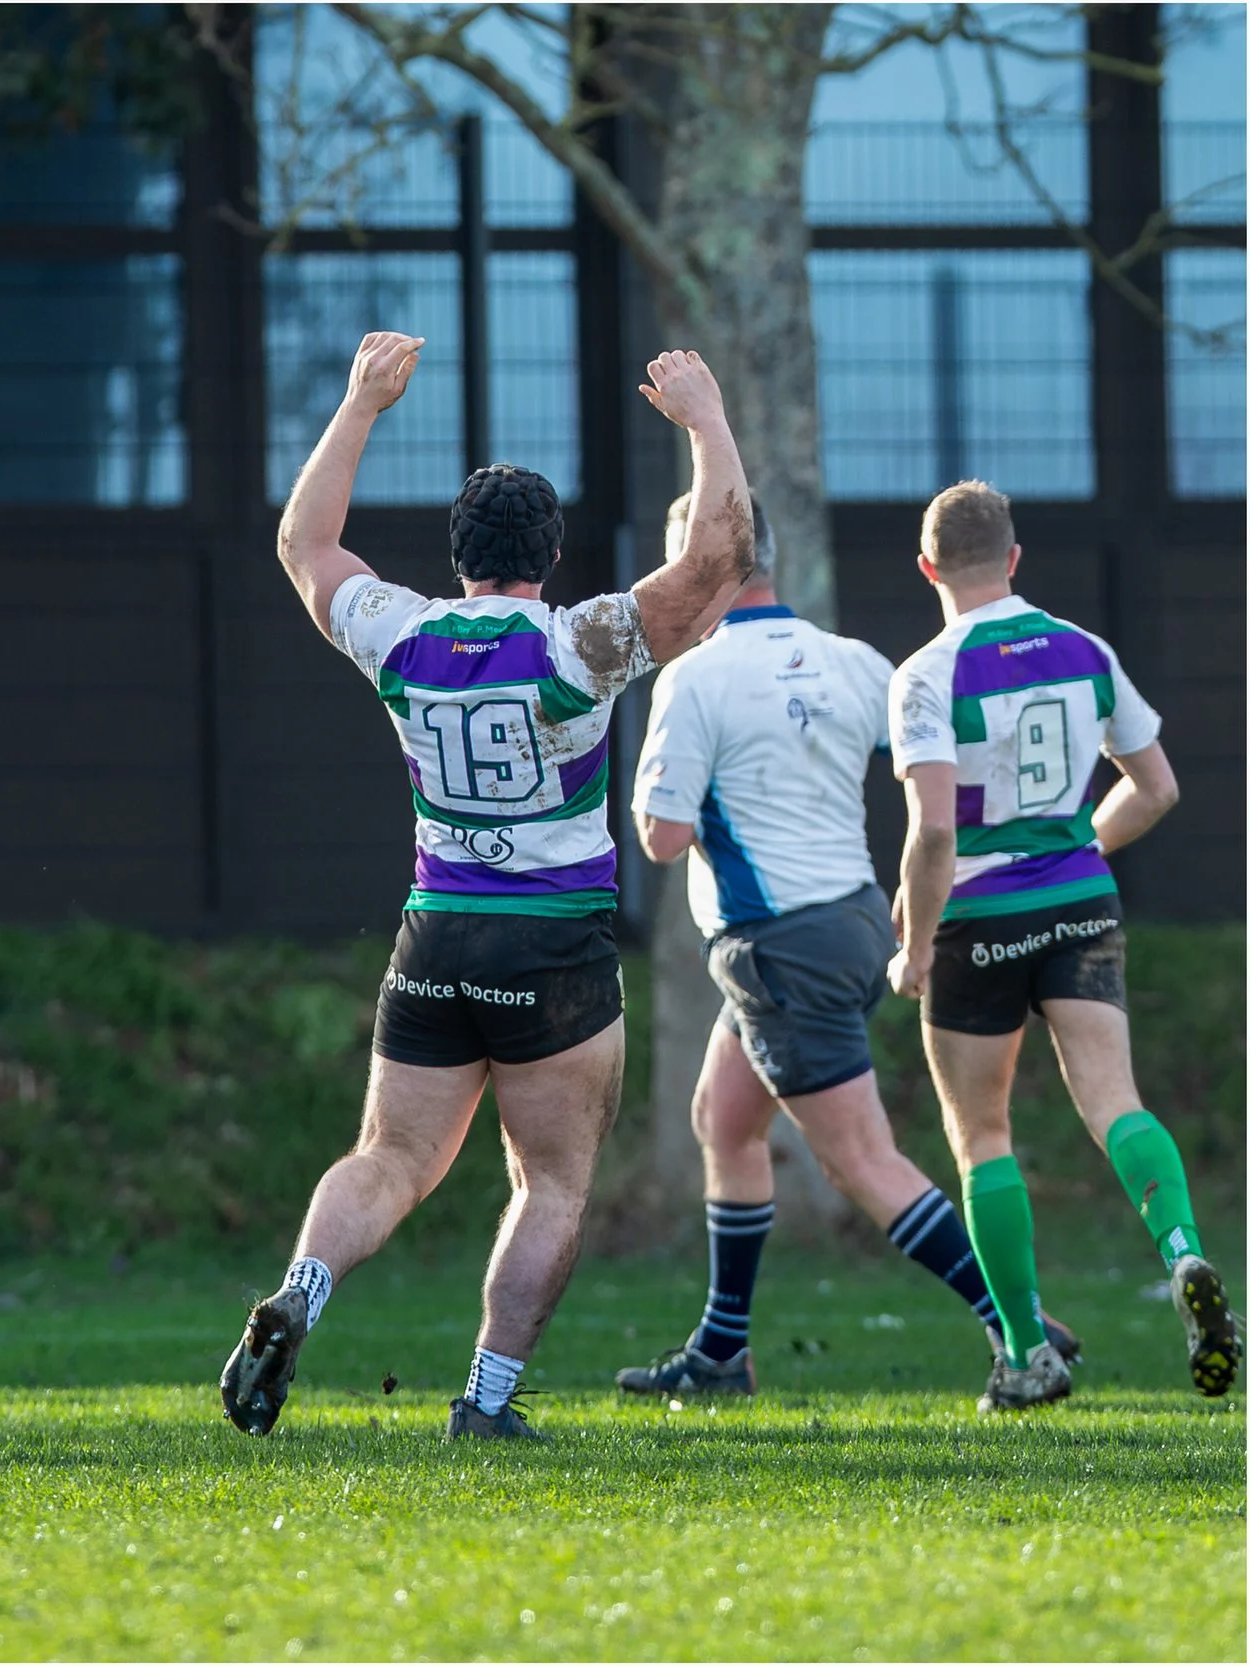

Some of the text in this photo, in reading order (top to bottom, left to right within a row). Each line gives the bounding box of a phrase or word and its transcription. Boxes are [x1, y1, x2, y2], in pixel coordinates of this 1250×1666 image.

[422, 698, 545, 803] 19
[1017, 698, 1071, 809] 9
[991, 931, 1052, 963] Device
[397, 973, 536, 1006] Device Doctors
